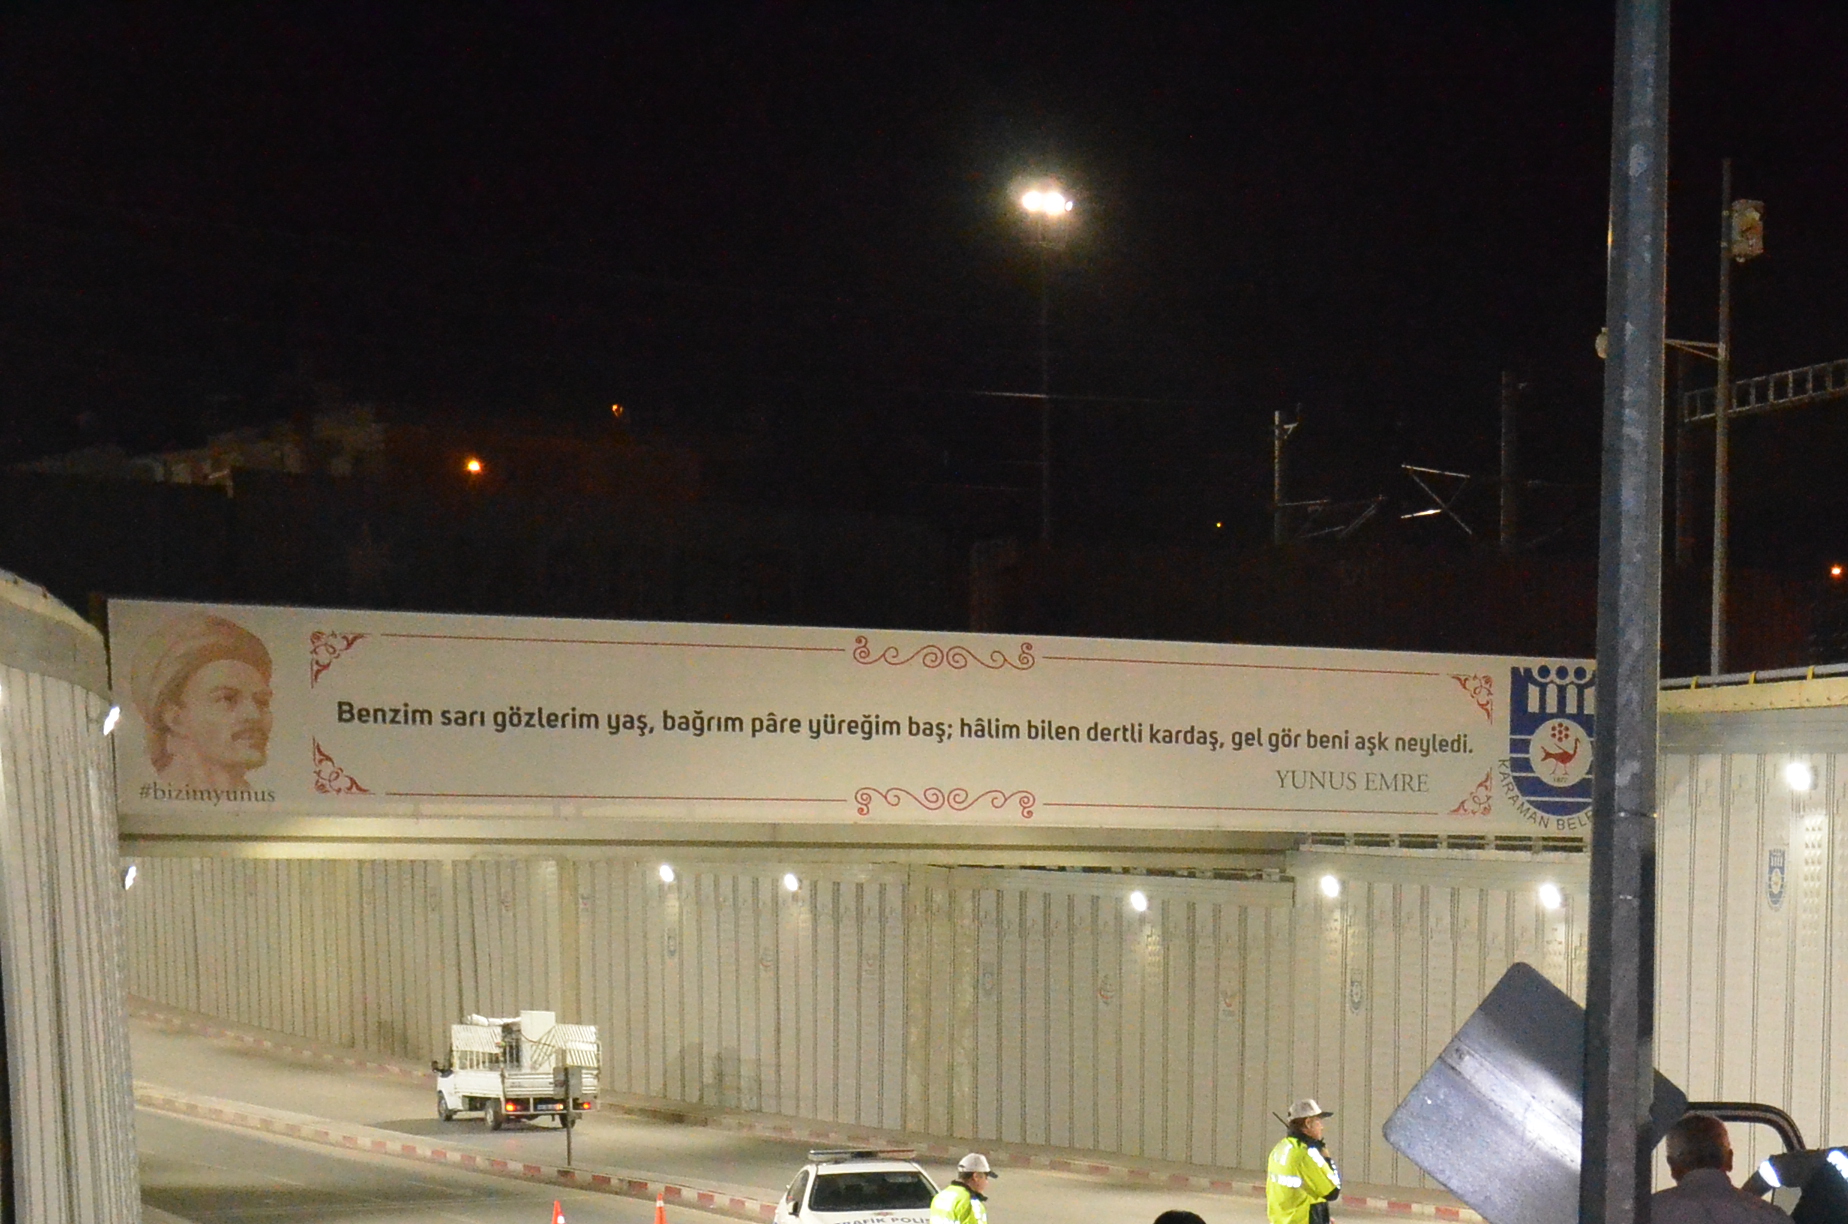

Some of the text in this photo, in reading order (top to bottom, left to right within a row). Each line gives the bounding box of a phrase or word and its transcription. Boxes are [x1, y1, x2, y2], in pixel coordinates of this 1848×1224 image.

[337, 700, 1474, 758] Benzim sarı gözlerim yaş, bağrım pâre yüreğim baş; hâlim bilen dertli kardaş, gel gör beni aşk neyledi.
[138, 781, 276, 807] #bizimyunus
[1275, 769, 1430, 793] YUNUS EMRE
[1498, 758, 1550, 830] KARAMAN
